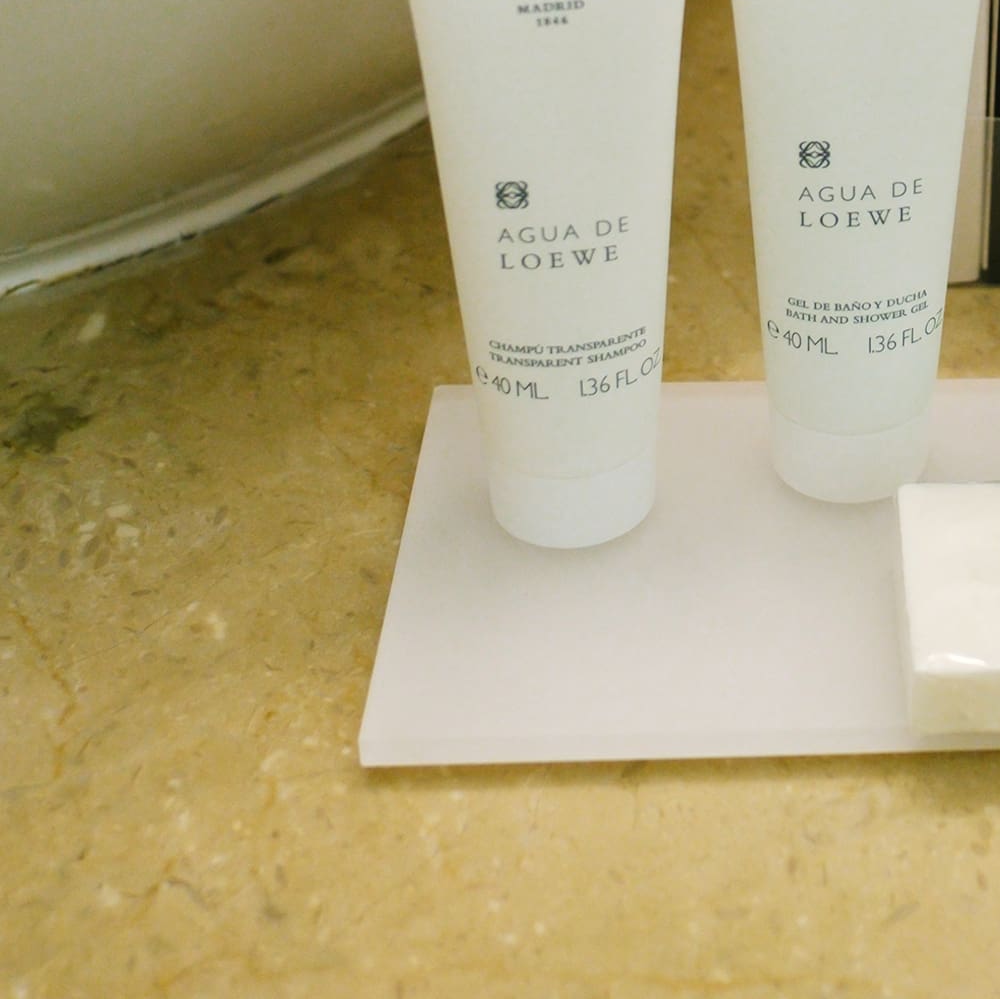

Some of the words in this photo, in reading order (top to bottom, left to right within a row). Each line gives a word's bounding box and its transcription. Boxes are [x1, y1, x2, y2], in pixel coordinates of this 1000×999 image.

[517, 0, 584, 15] MADRID
[536, 16, 568, 27] 1846
[799, 185, 876, 202] AGUA
[891, 178, 923, 198] DE
[800, 206, 912, 228] LOEWE
[498, 224, 580, 244] AGUA
[596, 216, 630, 237] DE
[501, 245, 619, 270] LOEWE
[786, 308, 817, 323] BATH
[820, 314, 849, 325] AND
[853, 309, 907, 324] SHOWER
[911, 300, 929, 314] GEL
[788, 297, 809, 309] GEL
[814, 302, 830, 311] DE
[835, 301, 871, 312] BAÑO
[874, 300, 883, 309] Y
[886, 289, 927, 308] DUCHA
[489, 340, 545, 354] CHAMPÚ
[549, 326, 647, 354] TRANSPARENTE
[783, 330, 802, 349] 40
[868, 333, 897, 354] 1.36
[489, 352, 583, 368] TRANSPARENT
[587, 339, 647, 364] SHAMPOO
[491, 375, 511, 395] 40
